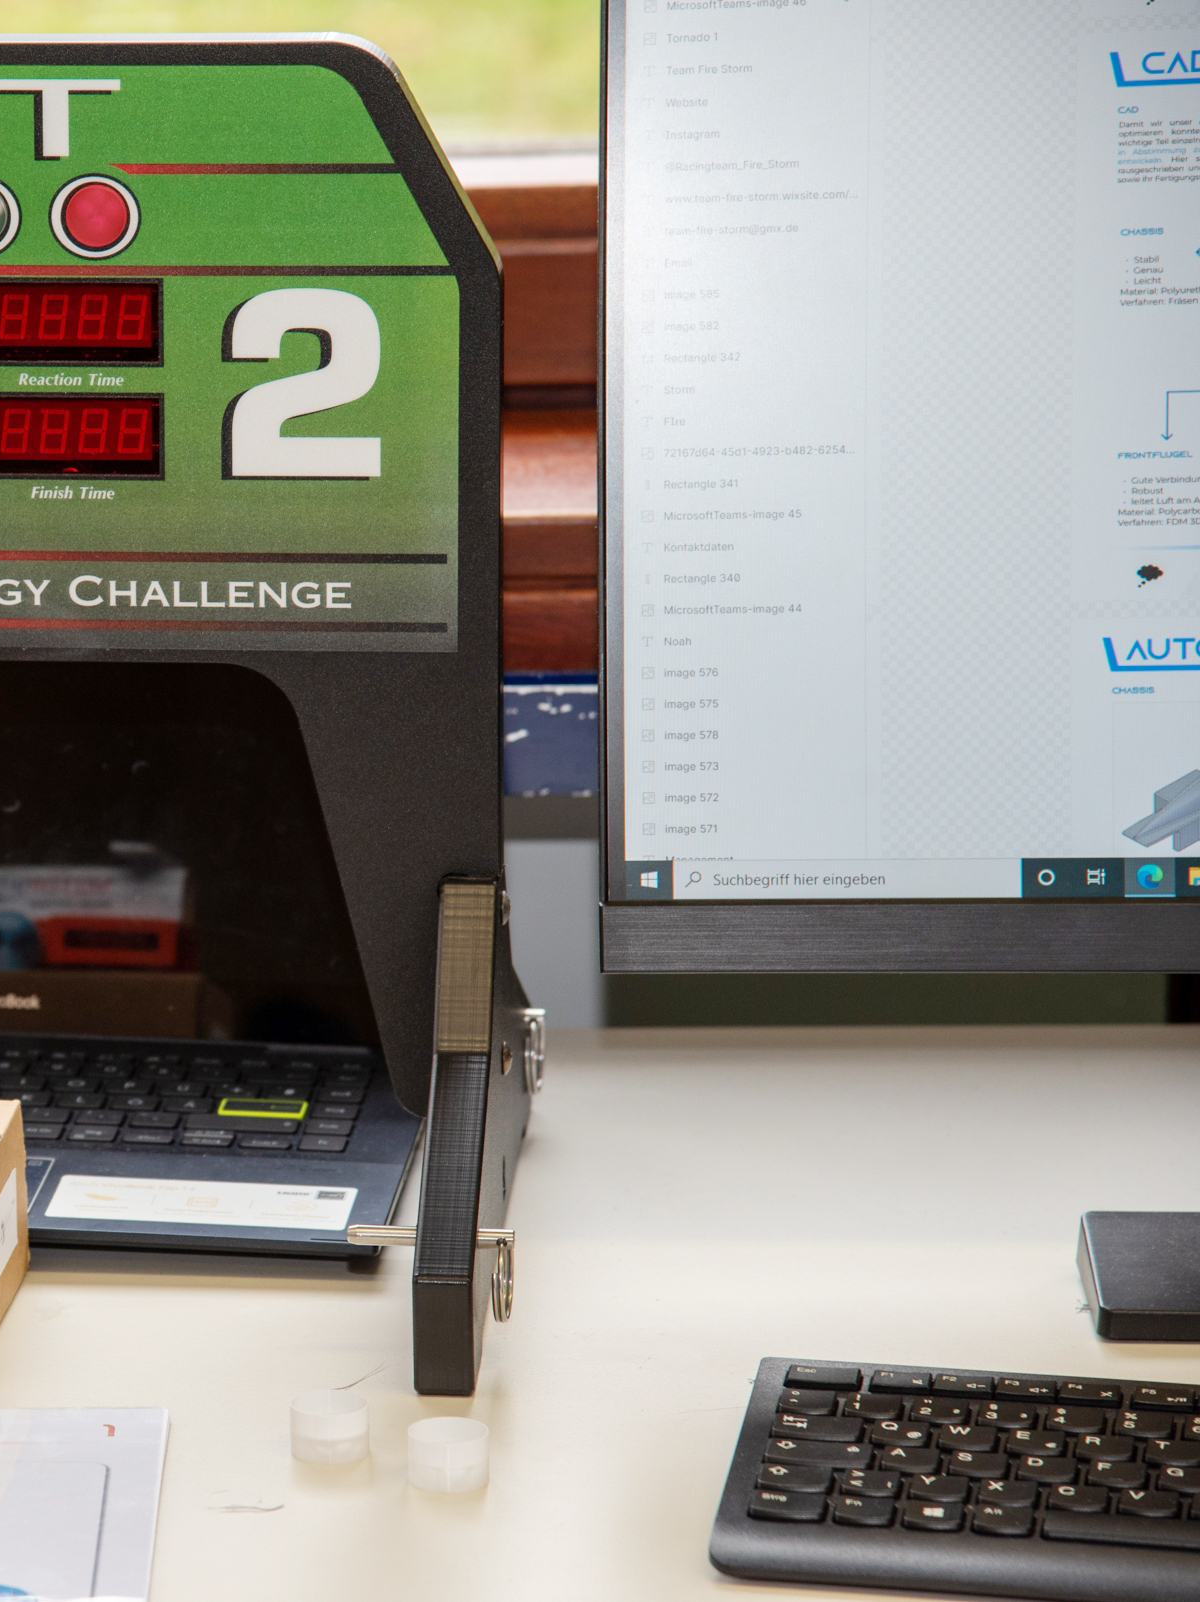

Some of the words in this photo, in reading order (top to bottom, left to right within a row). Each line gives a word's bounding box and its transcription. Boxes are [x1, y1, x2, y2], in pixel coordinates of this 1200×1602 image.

[666, 33, 710, 43] Tornado
[714, 32, 719, 41] 1
[666, 66, 695, 76] Team
[698, 65, 718, 74] Fire
[721, 64, 753, 74] Storm
[665, 98, 709, 108] Website
[1117, 106, 1139, 114] CAD
[1150, 119, 1163, 127] wir
[1169, 119, 1193, 127] unser
[665, 130, 721, 141] Instagram
[1118, 129, 1163, 138] optimieren
[1118, 139, 1153, 147] wichtige
[1132, 147, 1187, 156] Abstimmung
[665, 159, 800, 173] @Racingteam_Fire_Storm
[1117, 166, 1184, 175] rausgeschrieben
[1142, 175, 1153, 183] ihr
[664, 223, 799, 236] team-fire-storm@gmx.de
[1120, 227, 1164, 236] CHASSIS
[664, 259, 693, 268] Email
[1133, 255, 1160, 263] Stabil
[1133, 266, 1164, 274] Genau
[1133, 277, 1162, 285] Leicht
[664, 290, 696, 301] image
[699, 289, 720, 299] 585
[1120, 299, 1166, 307] Verfahren:
[1168, 297, 1199, 305] Fräsen
[664, 322, 696, 333] image
[699, 321, 719, 331] 582
[664, 353, 717, 364] Rectangle
[720, 352, 741, 362] 342
[18, 373, 83, 387] Reaction
[87, 373, 125, 388] Time
[221, 287, 381, 481] 2
[663, 385, 696, 395] Storm
[664, 480, 717, 491] Rectangle
[719, 479, 739, 488] 341
[1131, 476, 1154, 484] Gute
[31, 486, 75, 500] Finish
[79, 486, 115, 501] Time
[1131, 487, 1164, 495] Robust
[1131, 497, 1154, 505] leitet
[1156, 497, 1174, 505] Luft
[664, 510, 785, 521] MicrosoftTeams-image
[788, 509, 802, 518] 45
[1117, 508, 1156, 516] Material:
[663, 543, 734, 552] Kontaktdaten
[664, 574, 717, 585] Rectangle
[720, 573, 741, 583] 340
[69, 574, 352, 609] CHALLENGE
[664, 605, 785, 616] MicrosoftTeams-image
[788, 603, 802, 613] 44
[664, 637, 692, 646] Noah
[664, 668, 696, 679] image
[699, 667, 719, 677] 576
[664, 700, 696, 710] image
[699, 699, 719, 709] 575
[664, 731, 696, 742] image
[699, 731, 719, 740] 578
[664, 762, 696, 773] image
[699, 762, 719, 771] 573
[664, 793, 696, 804] image
[700, 793, 719, 802] 572
[665, 824, 697, 835] image
[700, 824, 718, 833] 571
[713, 873, 790, 888] Suchbegriff
[794, 874, 819, 886] hier
[823, 874, 886, 888] eingeben
[1004, 1379, 1020, 1387] F3
[1053, 1416, 1066, 1424] 4
[1123, 1421, 1136, 1429] 5
[881, 1421, 899, 1431] Q
[949, 1425, 971, 1435] W
[1016, 1430, 1031, 1440] E
[1085, 1435, 1100, 1446] R
[1155, 1440, 1170, 1449] T
[890, 1448, 906, 1458] A
[957, 1452, 973, 1462] S
[1027, 1457, 1044, 1467] D
[1097, 1462, 1112, 1471] F
[1166, 1467, 1184, 1477] G
[920, 1474, 937, 1486] Y
[987, 1480, 1004, 1492] X
[1058, 1486, 1076, 1496] C
[1128, 1490, 1145, 1500] V
